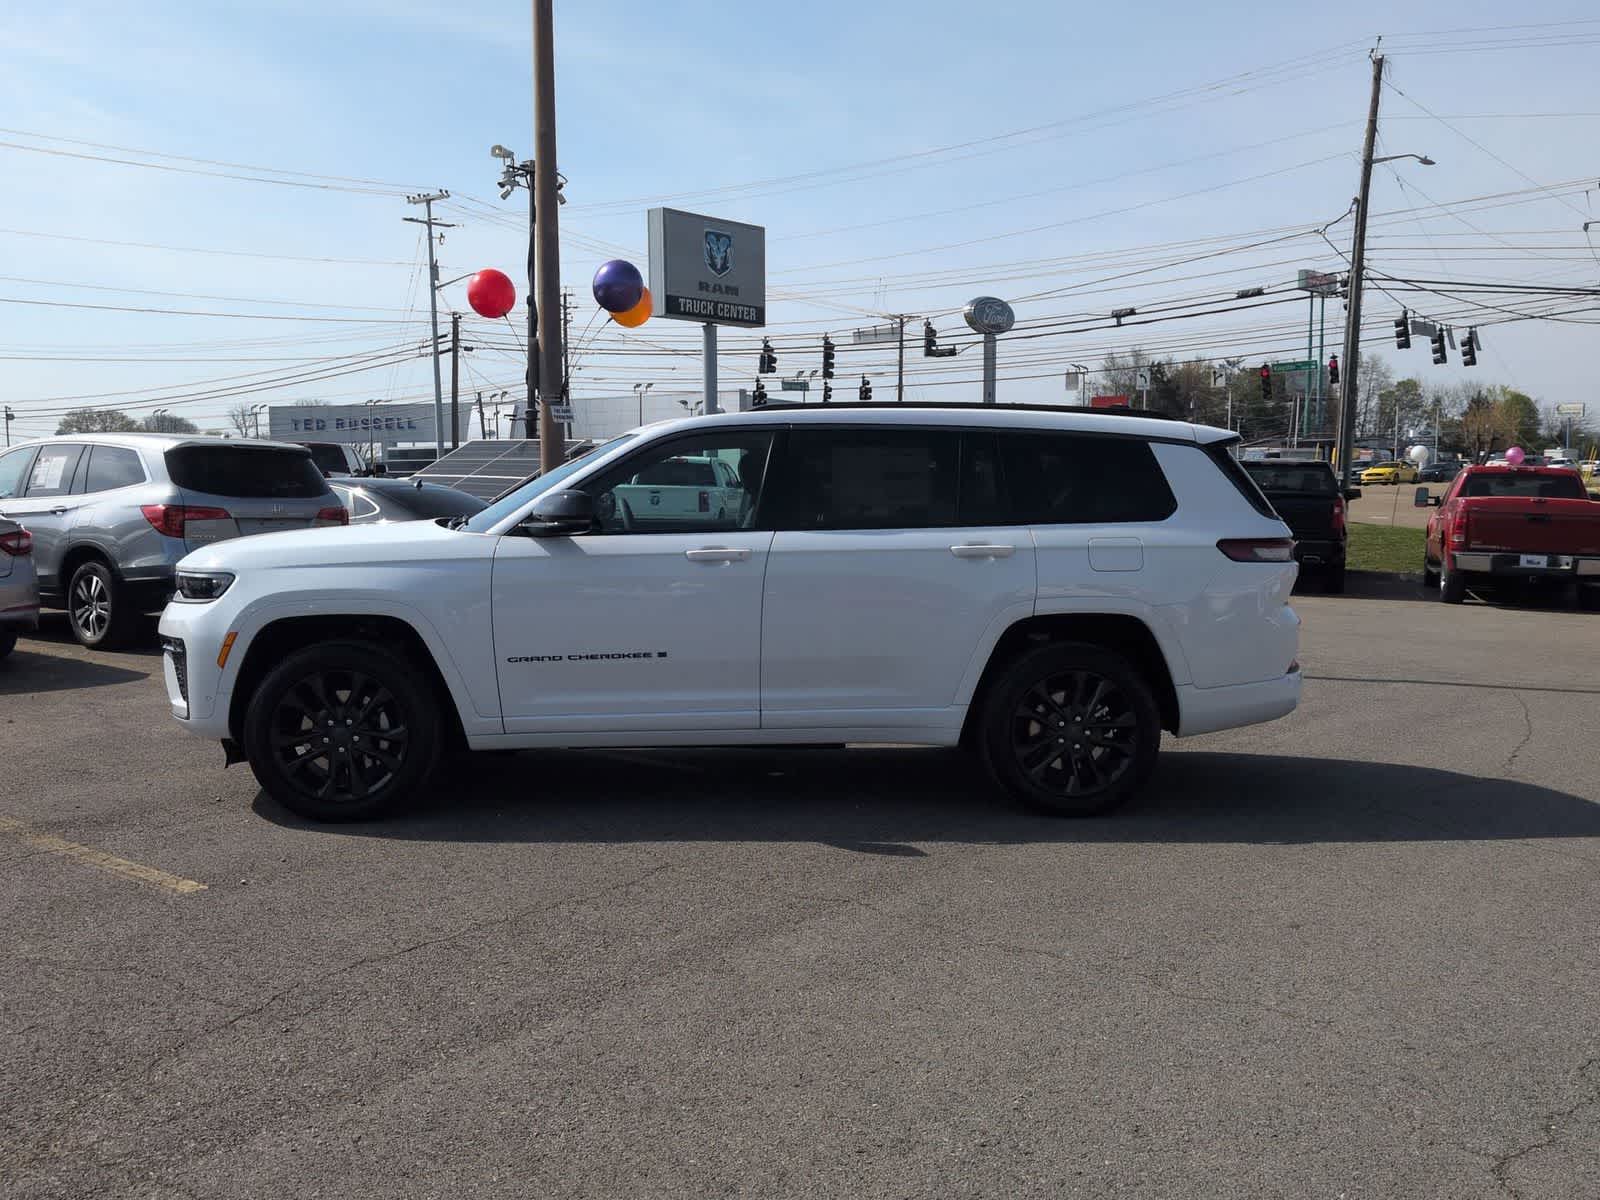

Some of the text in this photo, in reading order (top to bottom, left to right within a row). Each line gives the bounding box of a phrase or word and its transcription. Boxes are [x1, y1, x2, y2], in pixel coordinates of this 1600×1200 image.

[698, 281, 739, 297] RAM
[678, 298, 757, 321] TRUCK CENTER
[983, 303, 1009, 325] Ford
[291, 416, 417, 431] TED RUSSELL
[507, 655, 563, 663] GRAND
[567, 651, 653, 661] CHEROKEE
